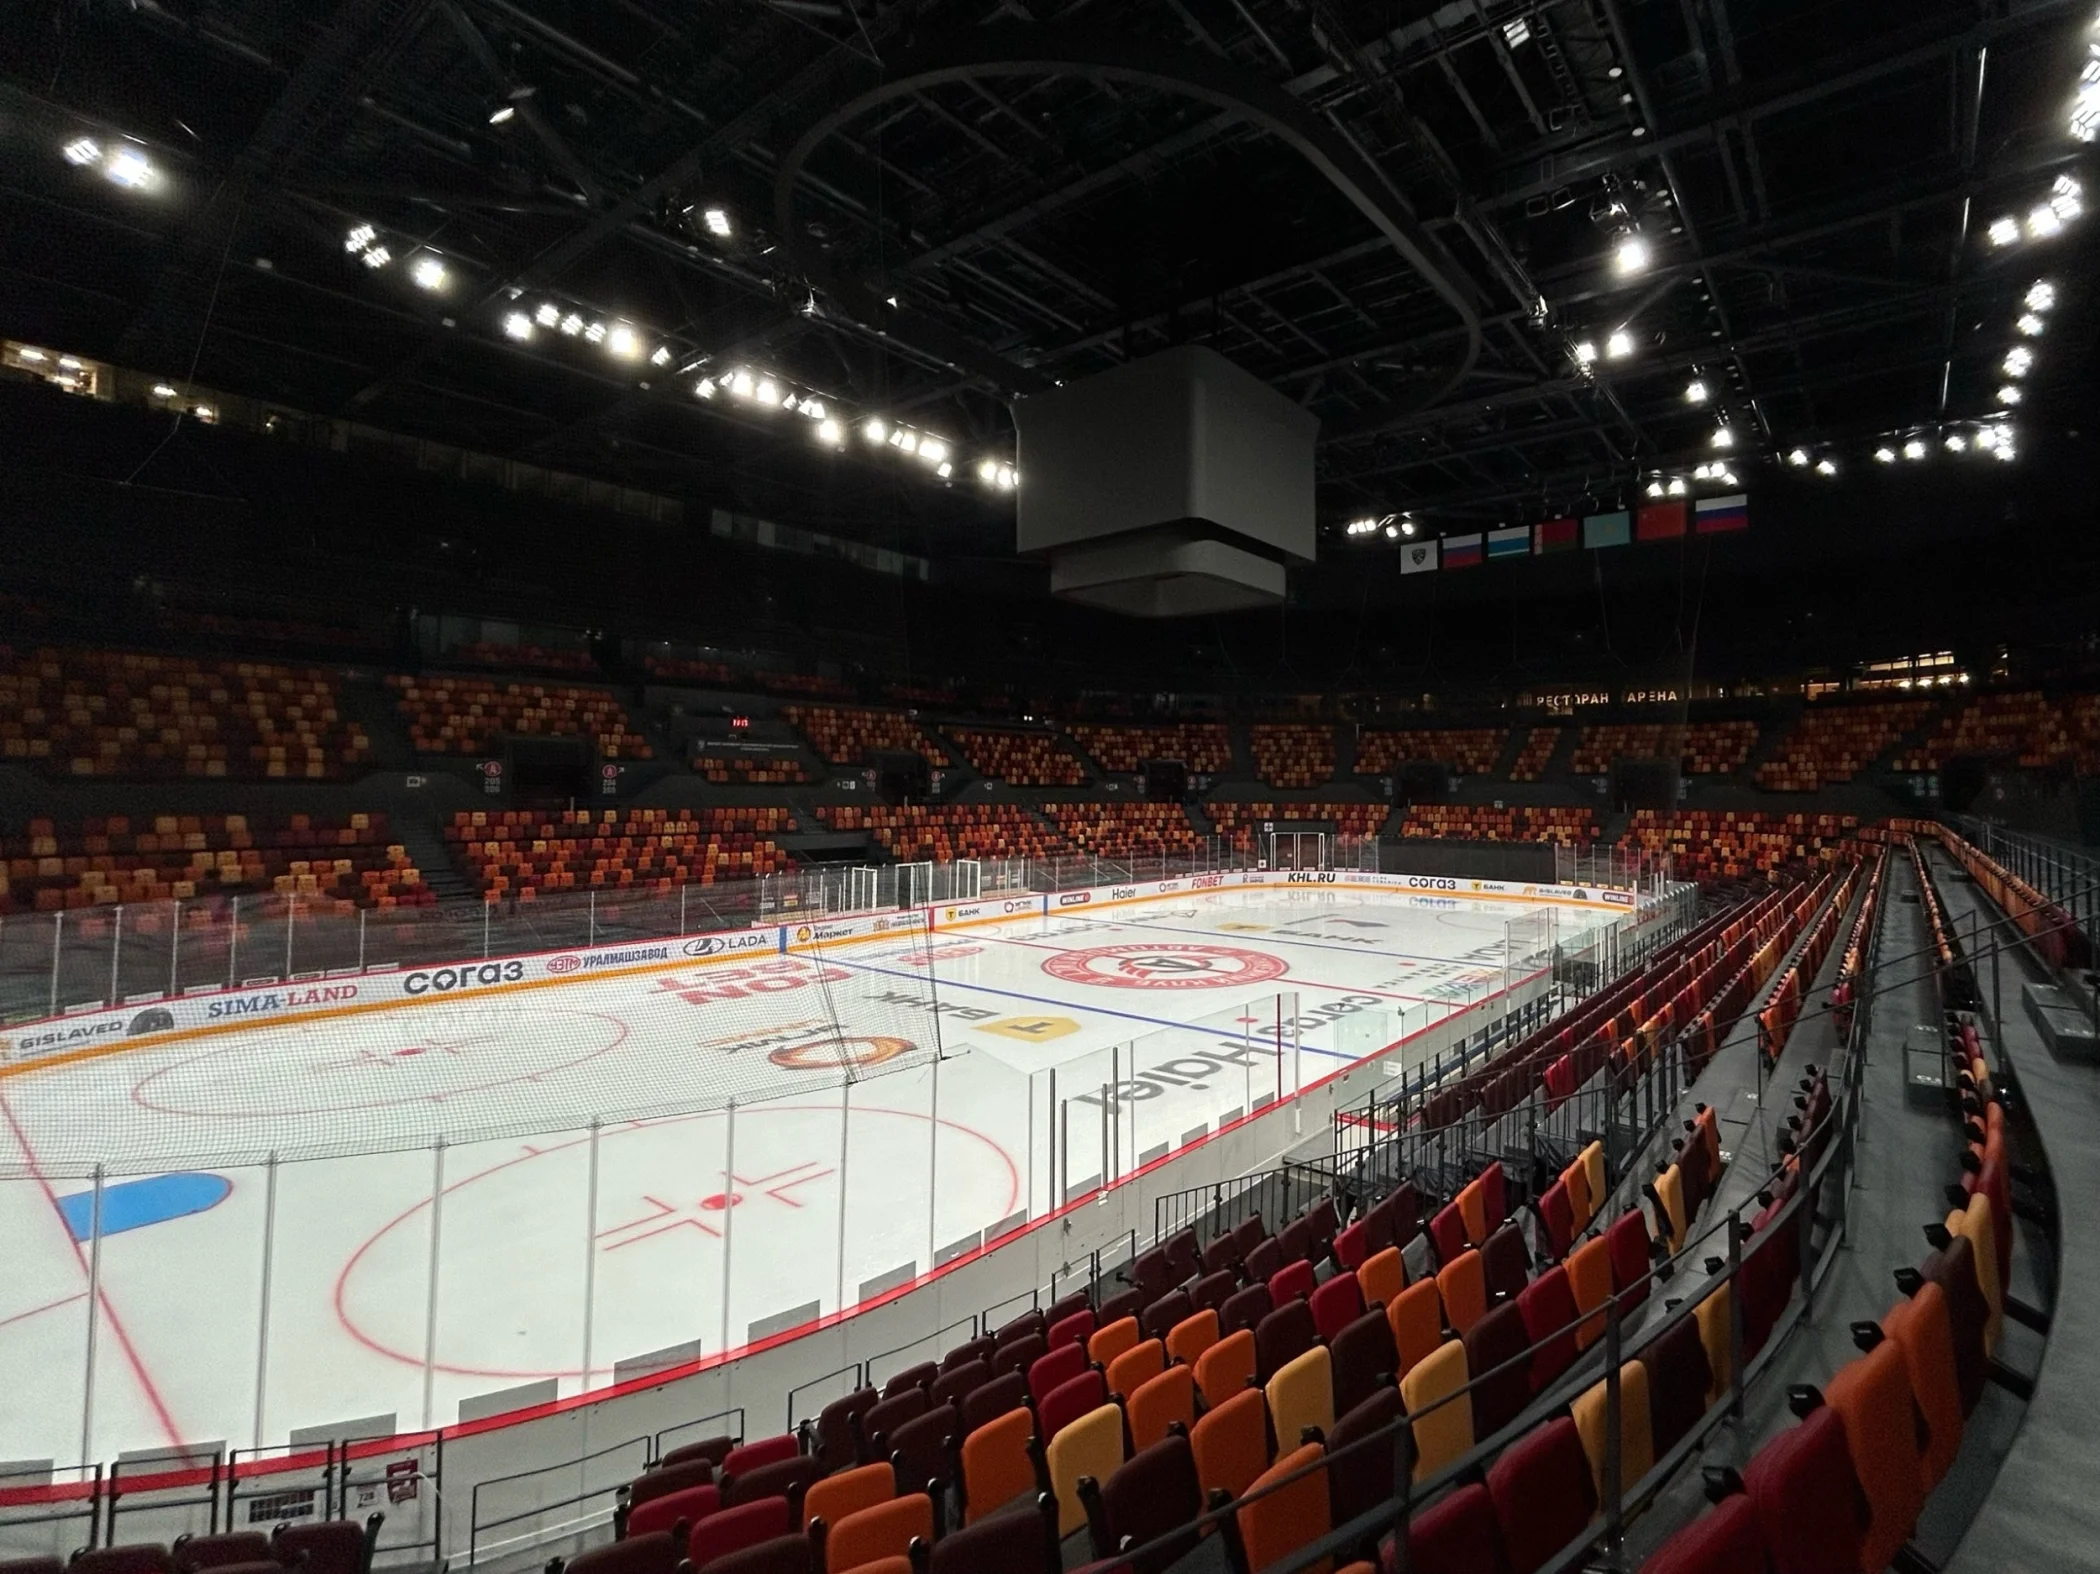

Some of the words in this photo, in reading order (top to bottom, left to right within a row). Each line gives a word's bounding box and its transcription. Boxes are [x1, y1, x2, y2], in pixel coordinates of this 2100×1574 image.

[1626, 690, 1678, 703] АРЕНА
[1191, 875, 1224, 889] FONBET
[1287, 872, 1336, 883] KHL.RU
[1111, 887, 1137, 900] Haier
[958, 907, 980, 917] БАНК
[812, 927, 854, 940] Маркет
[728, 934, 767, 949] LADA
[583, 947, 668, 969] УРАЛМАШЗАВОД
[207, 983, 359, 1019] SIMA-LAND
[19, 1020, 123, 1050] GISLAVED
